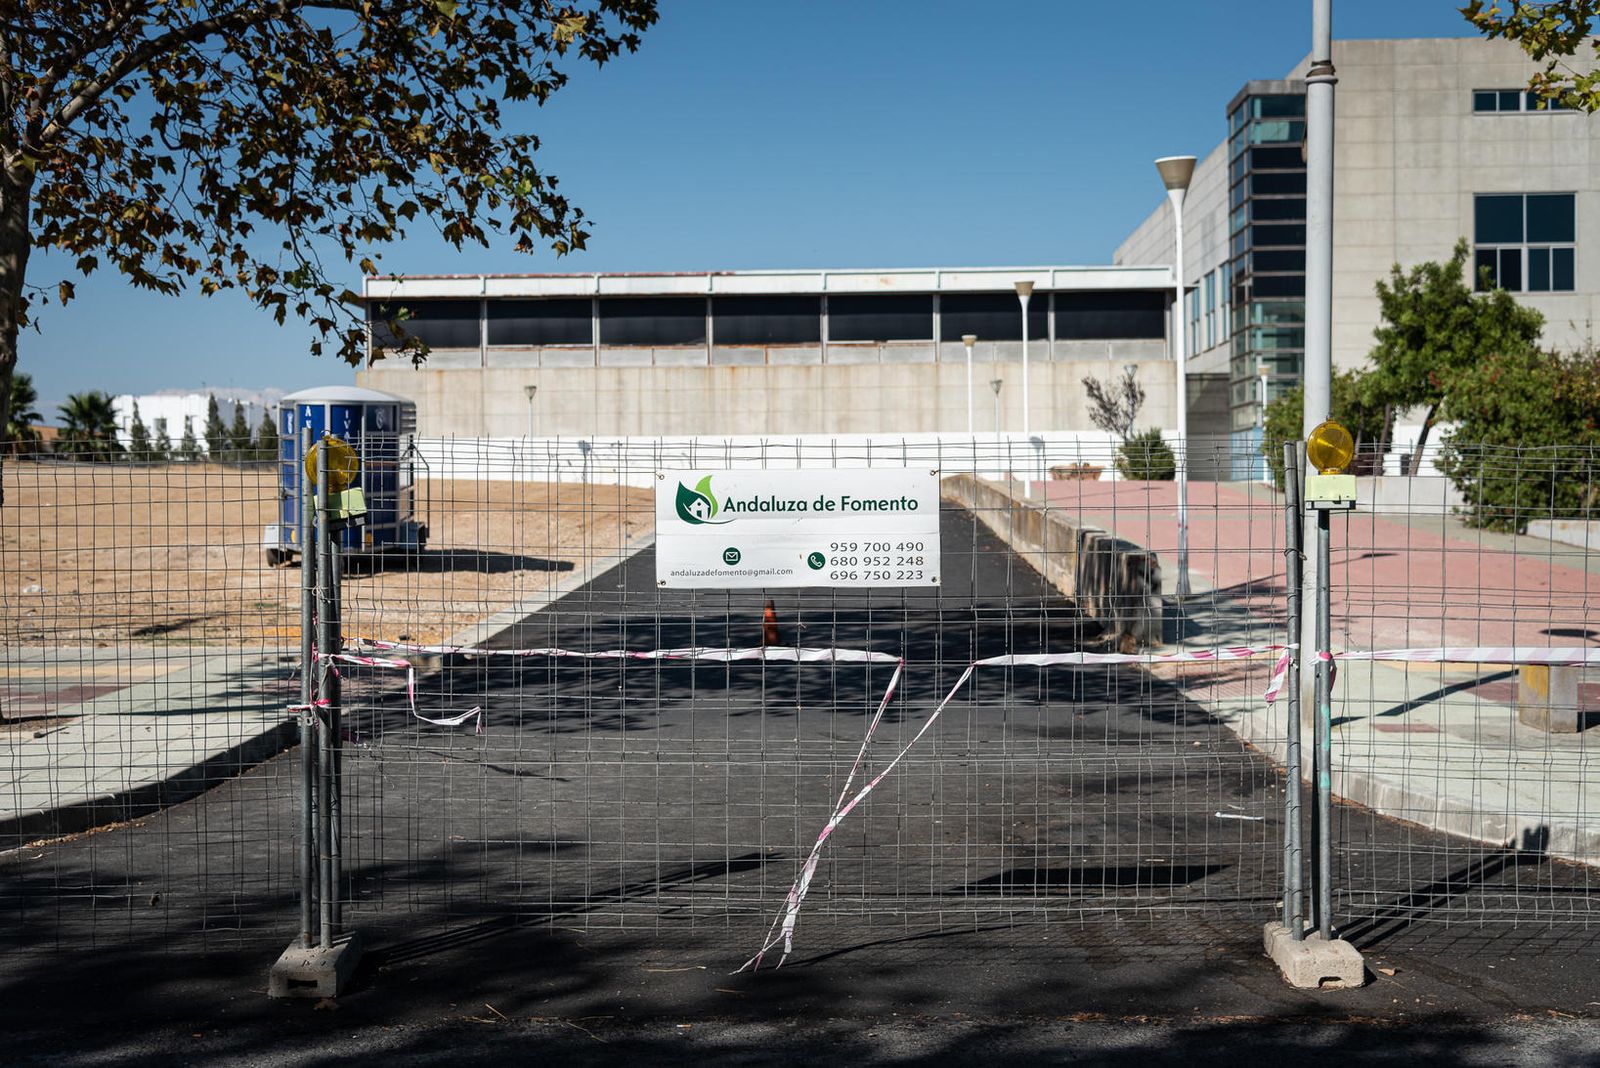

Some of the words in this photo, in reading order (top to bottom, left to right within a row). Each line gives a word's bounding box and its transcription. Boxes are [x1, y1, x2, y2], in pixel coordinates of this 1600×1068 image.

[723, 495, 808, 513] Andaluza
[812, 494, 836, 512] de
[841, 495, 919, 512] Fomento
[830, 542, 858, 552] 959
[863, 542, 891, 552] 700
[896, 541, 924, 552] 490
[830, 556, 858, 567] 680
[863, 556, 891, 566] 952
[896, 555, 924, 566] 248
[670, 568, 794, 578] andaluzadefomento@gmail.com
[830, 570, 858, 580] 696
[863, 570, 891, 580] 750
[896, 569, 924, 580] 223
